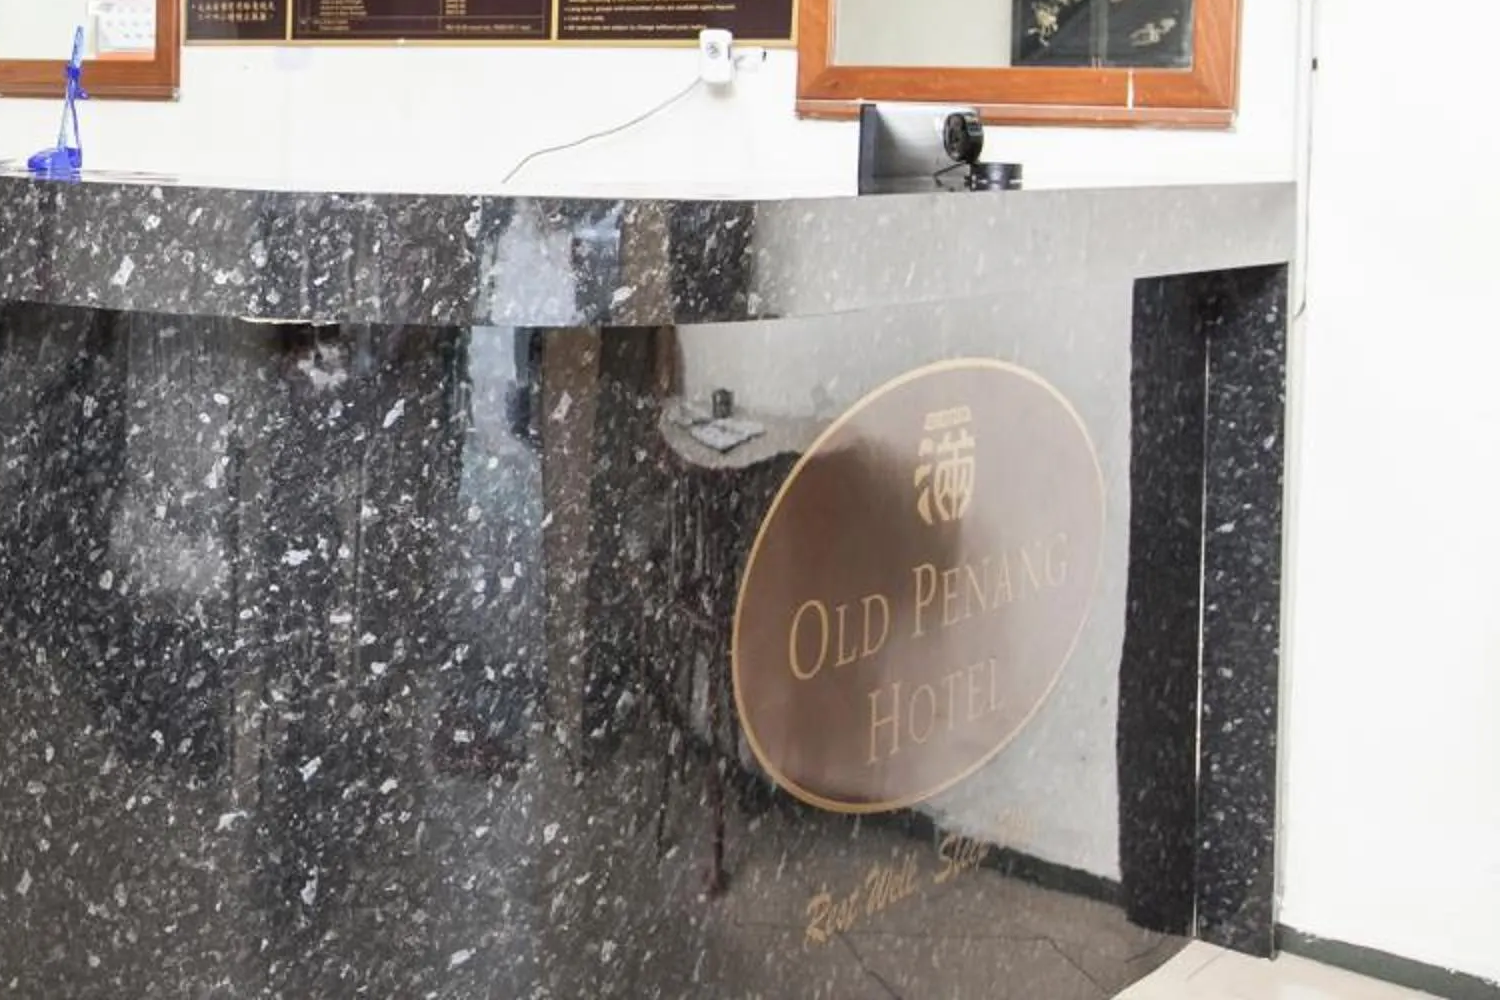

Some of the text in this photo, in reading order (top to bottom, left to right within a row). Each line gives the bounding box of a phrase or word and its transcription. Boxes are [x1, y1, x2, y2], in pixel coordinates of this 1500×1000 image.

[789, 532, 1069, 680] OLD PENANG
[867, 659, 999, 765] HOTEL
